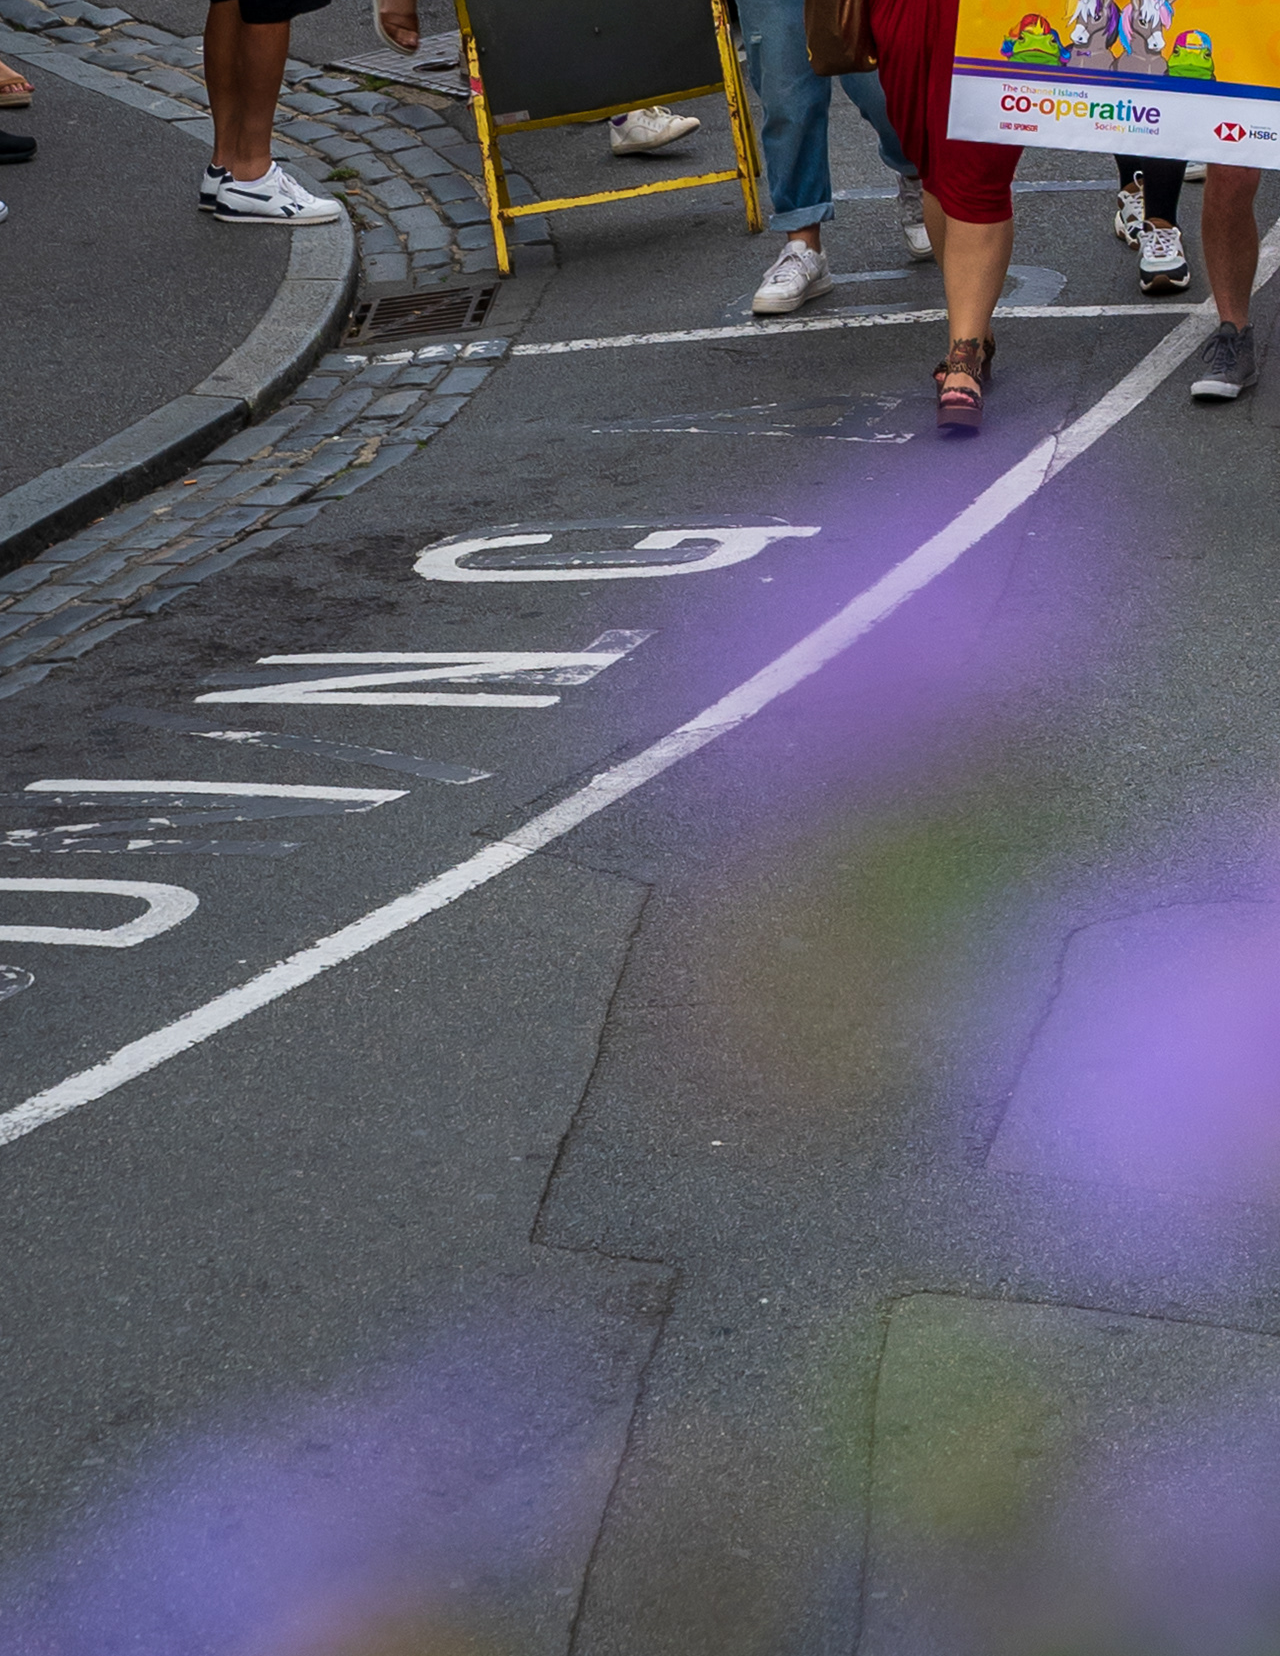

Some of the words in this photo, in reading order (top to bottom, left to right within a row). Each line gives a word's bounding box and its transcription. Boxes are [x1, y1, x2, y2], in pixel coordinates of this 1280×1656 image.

[1001, 94, 1161, 125] co-operative
[1128, 125, 1160, 136] Limited
[1249, 130, 1278, 141] HSBC
